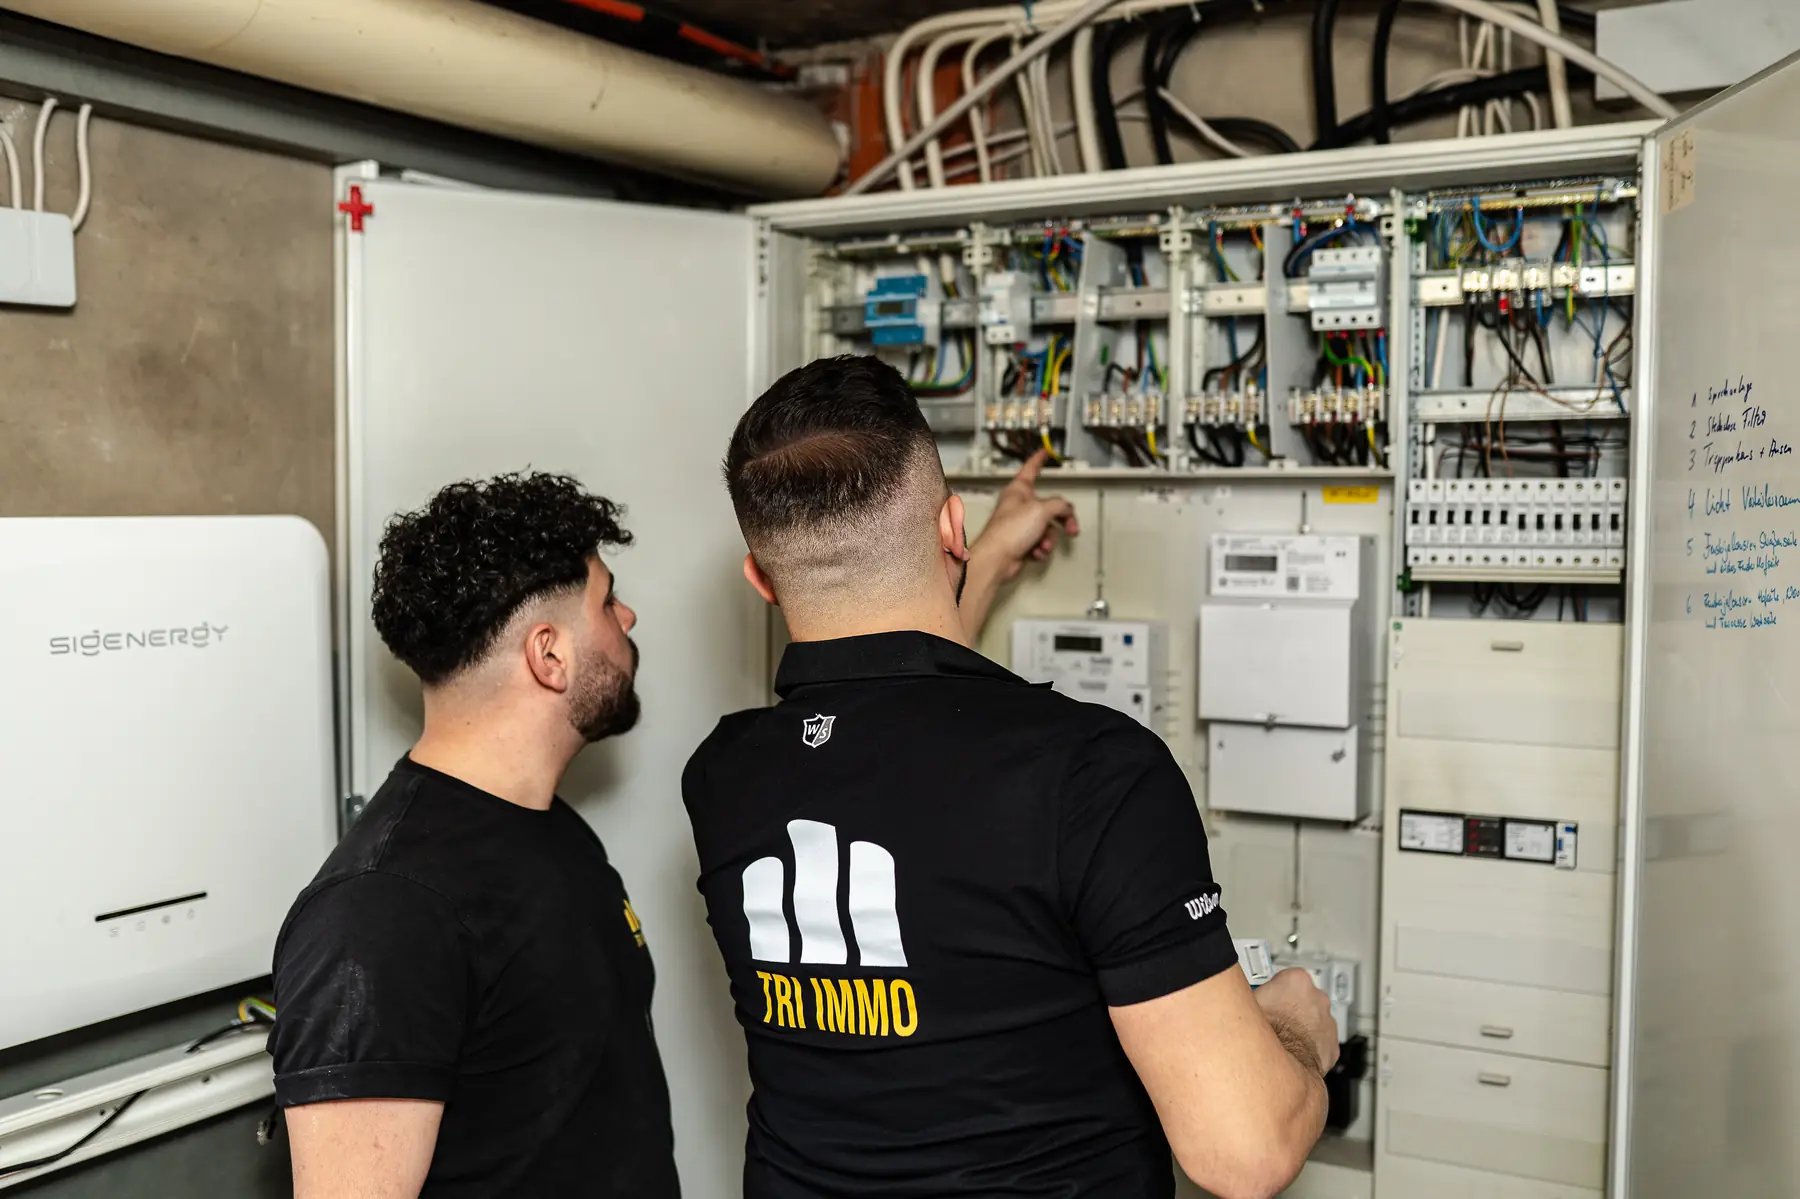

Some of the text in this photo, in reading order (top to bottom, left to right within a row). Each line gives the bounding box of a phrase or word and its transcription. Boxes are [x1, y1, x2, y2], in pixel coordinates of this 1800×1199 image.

[1689, 420, 1696, 439] 2
[1742, 405, 1766, 429] Filter
[1688, 449, 1696, 471] 3
[1688, 488, 1695, 519] 4
[1706, 488, 1731, 516] Licht
[1687, 538, 1694, 556] 5
[1687, 594, 1692, 614] 6
[756, 970, 918, 1037] TRI IMMO
